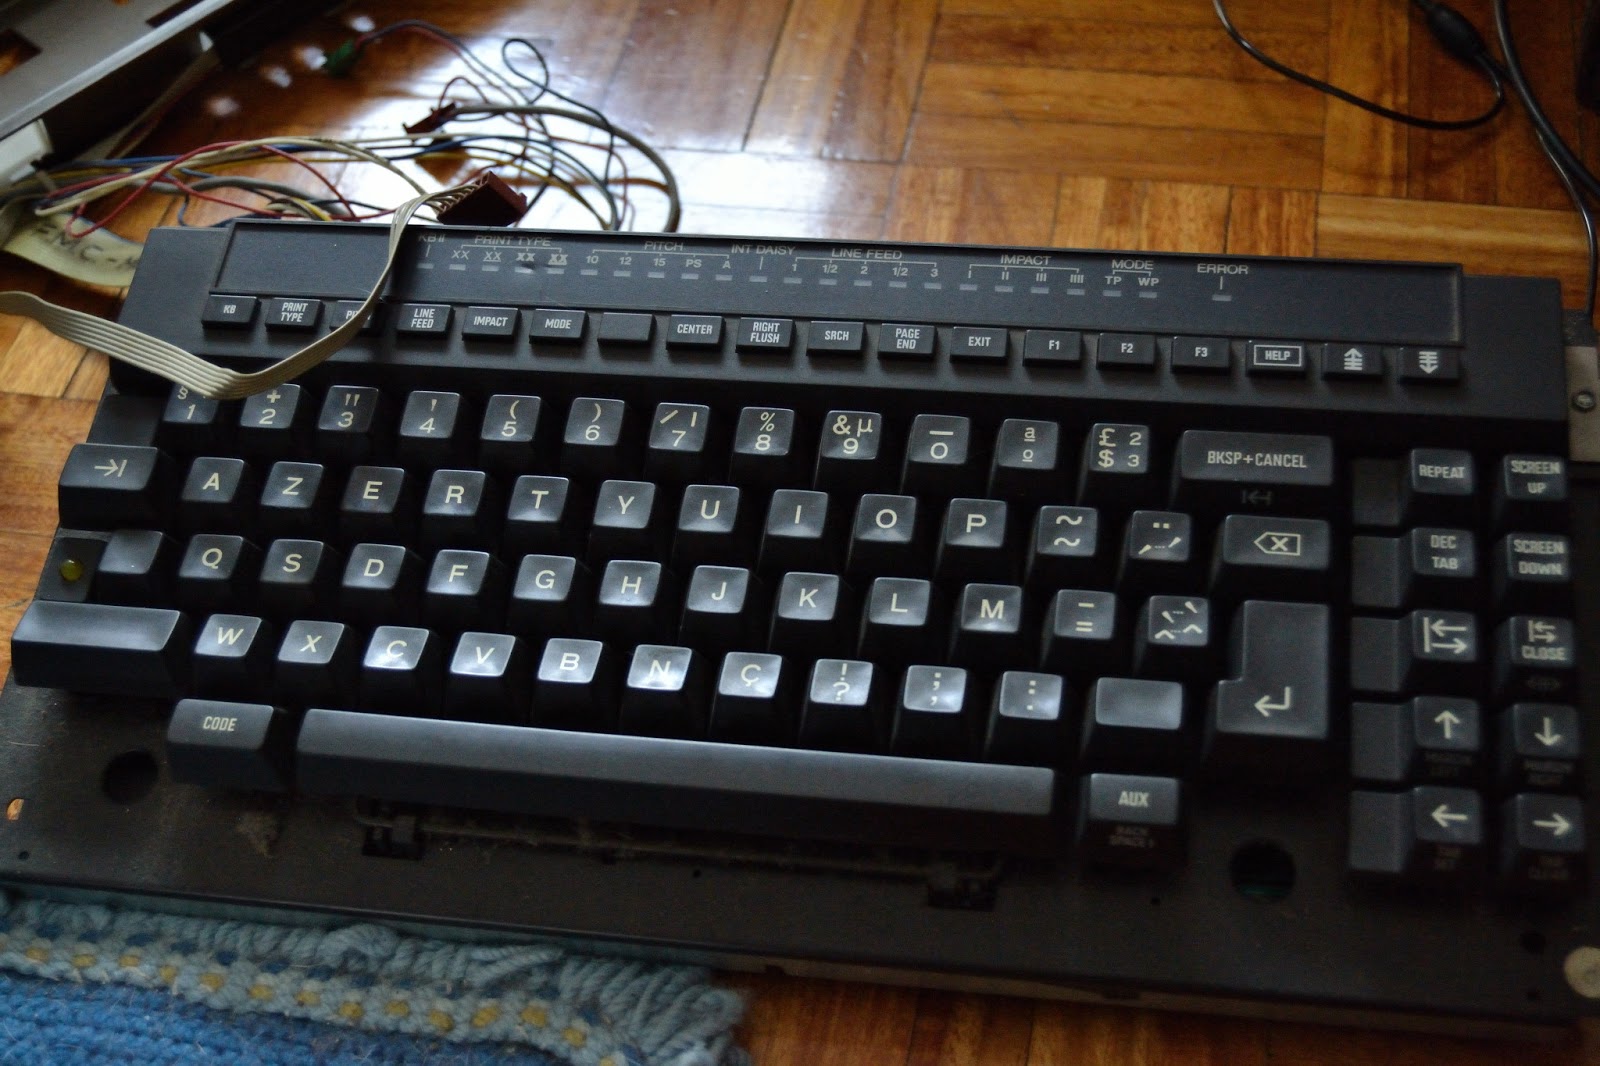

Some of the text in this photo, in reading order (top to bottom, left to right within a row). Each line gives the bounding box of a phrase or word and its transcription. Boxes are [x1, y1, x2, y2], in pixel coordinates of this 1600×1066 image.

[474, 234, 553, 247] PRINT TYPE
[644, 241, 684, 251] PITCH
[731, 244, 796, 256] INT DAISY
[831, 248, 903, 260] LINE FEED
[585, 255, 731, 269] 10 12 15 PS A
[1000, 255, 1052, 266] IMPACT
[1111, 259, 1154, 270] MODE
[860, 266, 868, 275] 2
[930, 268, 939, 278] 3
[1197, 263, 1249, 275] ERROR
[1105, 275, 1160, 287] TP WP
[222, 304, 236, 314] KB
[281, 301, 309, 313] PRINT
[413, 307, 435, 319] LINE
[280, 311, 303, 323] TYPE
[410, 318, 434, 329] FEED
[473, 315, 508, 328] IMPACT
[545, 317, 572, 330] MODE
[676, 323, 713, 335] CENTER
[752, 321, 780, 334] RIGHT
[824, 329, 849, 341] SRCH
[895, 327, 920, 340] PAGE
[750, 331, 780, 344] FLUSH
[896, 337, 917, 349] END
[967, 336, 992, 348] EXIT
[1048, 339, 1061, 351] F1
[1120, 342, 1134, 354] F2
[1194, 345, 1209, 357] F3
[1264, 349, 1292, 362] HELP
[258, 408, 277, 425] 2
[337, 412, 354, 428] 3
[759, 412, 776, 432] %
[419, 417, 436, 434] 4
[501, 421, 517, 437] 5
[585, 425, 600, 441] 6
[671, 430, 687, 447] 7
[754, 434, 771, 451] 8
[1098, 427, 1116, 447] £
[842, 437, 859, 455] 9
[1097, 448, 1115, 469] $
[1207, 450, 1307, 468] BKSP+CANCEL
[1418, 464, 1466, 479] REPEAT
[1510, 460, 1561, 475] SCREEN
[202, 472, 220, 490] A
[282, 477, 303, 495] Z
[1527, 482, 1547, 494] UP
[362, 481, 383, 500] E
[444, 485, 465, 504] R
[531, 490, 549, 509] T
[618, 495, 635, 515] Y
[700, 500, 720, 520] U
[793, 505, 802, 524] I
[875, 508, 898, 529] O
[966, 513, 987, 533] P
[1430, 534, 1457, 549] DEC
[1513, 539, 1565, 554] SCREEN
[201, 547, 223, 570] Q
[282, 553, 303, 573] S
[1431, 556, 1459, 570] TAB
[363, 558, 384, 577] D
[448, 564, 468, 583] F
[1518, 561, 1563, 576] DOWN
[534, 569, 557, 589] G
[620, 575, 642, 595] H
[711, 581, 727, 601] J
[798, 588, 819, 608] K
[890, 592, 908, 612] L
[980, 599, 1005, 620] M
[216, 626, 244, 645] W
[299, 634, 322, 653] X
[385, 640, 408, 659] C
[475, 646, 495, 665] V
[1521, 645, 1567, 661] CLOSE
[559, 652, 580, 671] B
[649, 659, 671, 679] N
[740, 664, 762, 688] Ç
[202, 715, 237, 732] CODE
[1118, 790, 1150, 808] AUX
